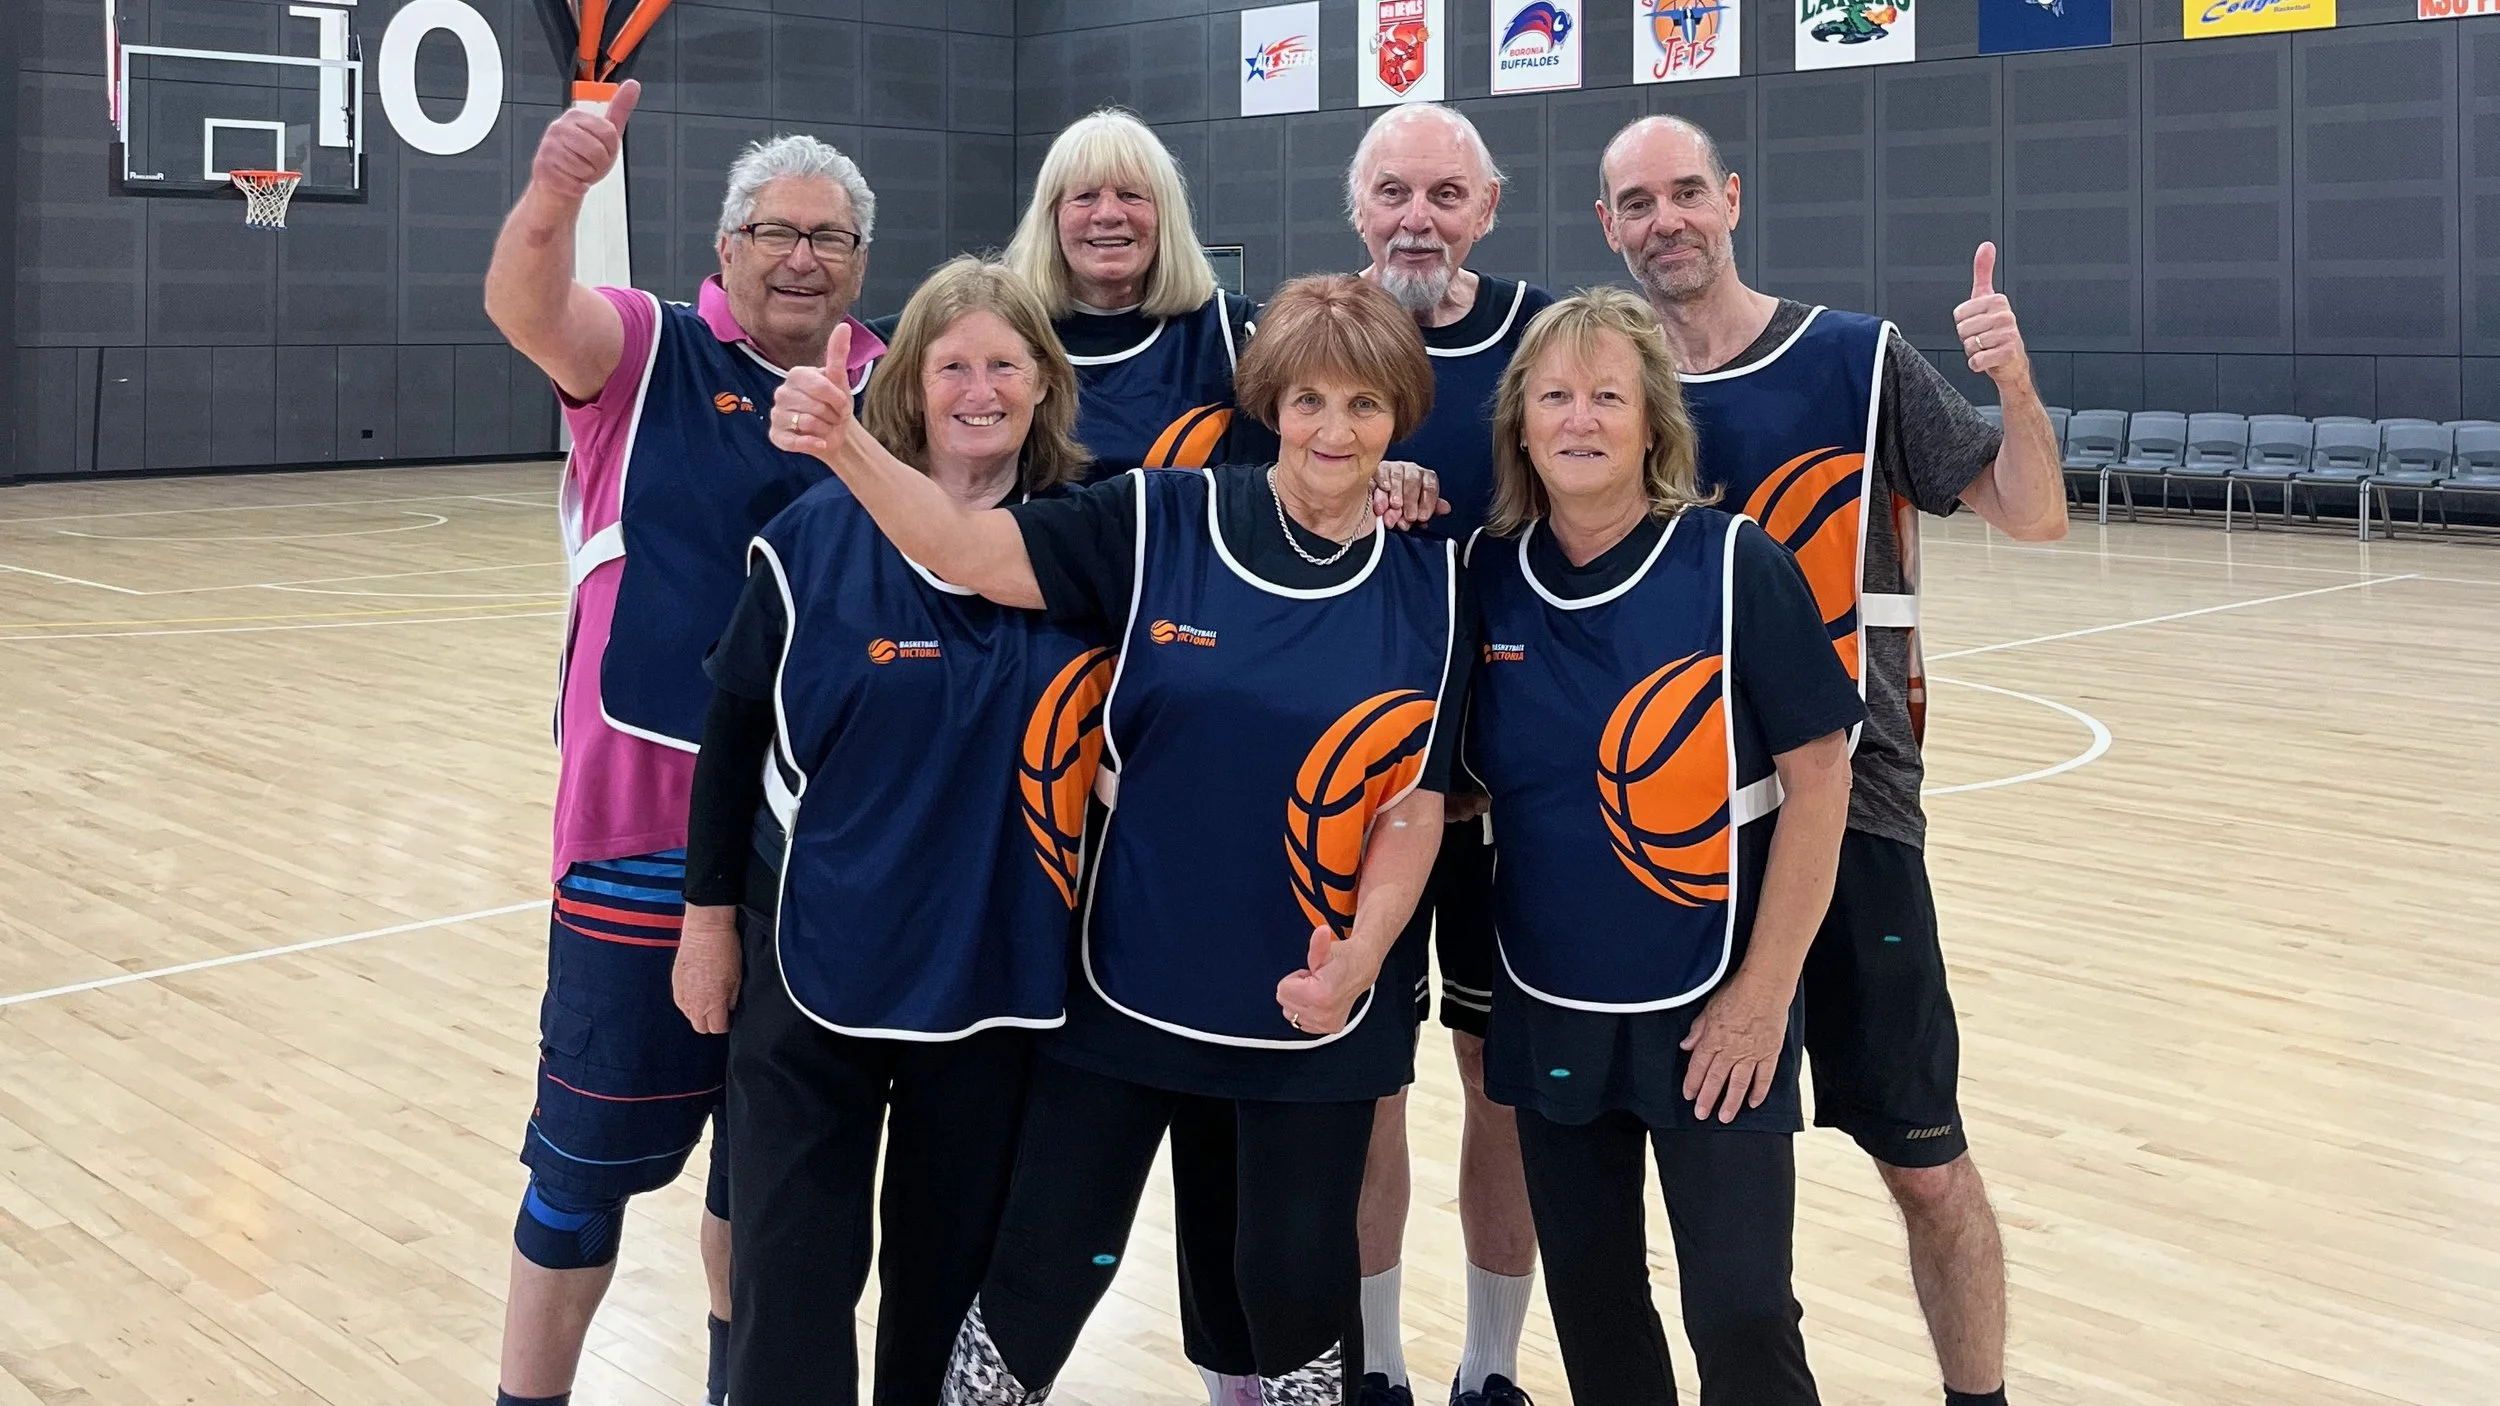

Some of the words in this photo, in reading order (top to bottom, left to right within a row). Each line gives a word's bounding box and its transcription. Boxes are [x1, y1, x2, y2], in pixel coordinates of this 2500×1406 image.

[1509, 47, 1544, 57] BORONIA
[1653, 35, 1717, 79] JETS
[1501, 55, 1560, 70] BUFFALOES
[289, 0, 504, 156] 10
[1179, 624, 1217, 638] BASKETBALL
[900, 648, 942, 658] VICTORIA
